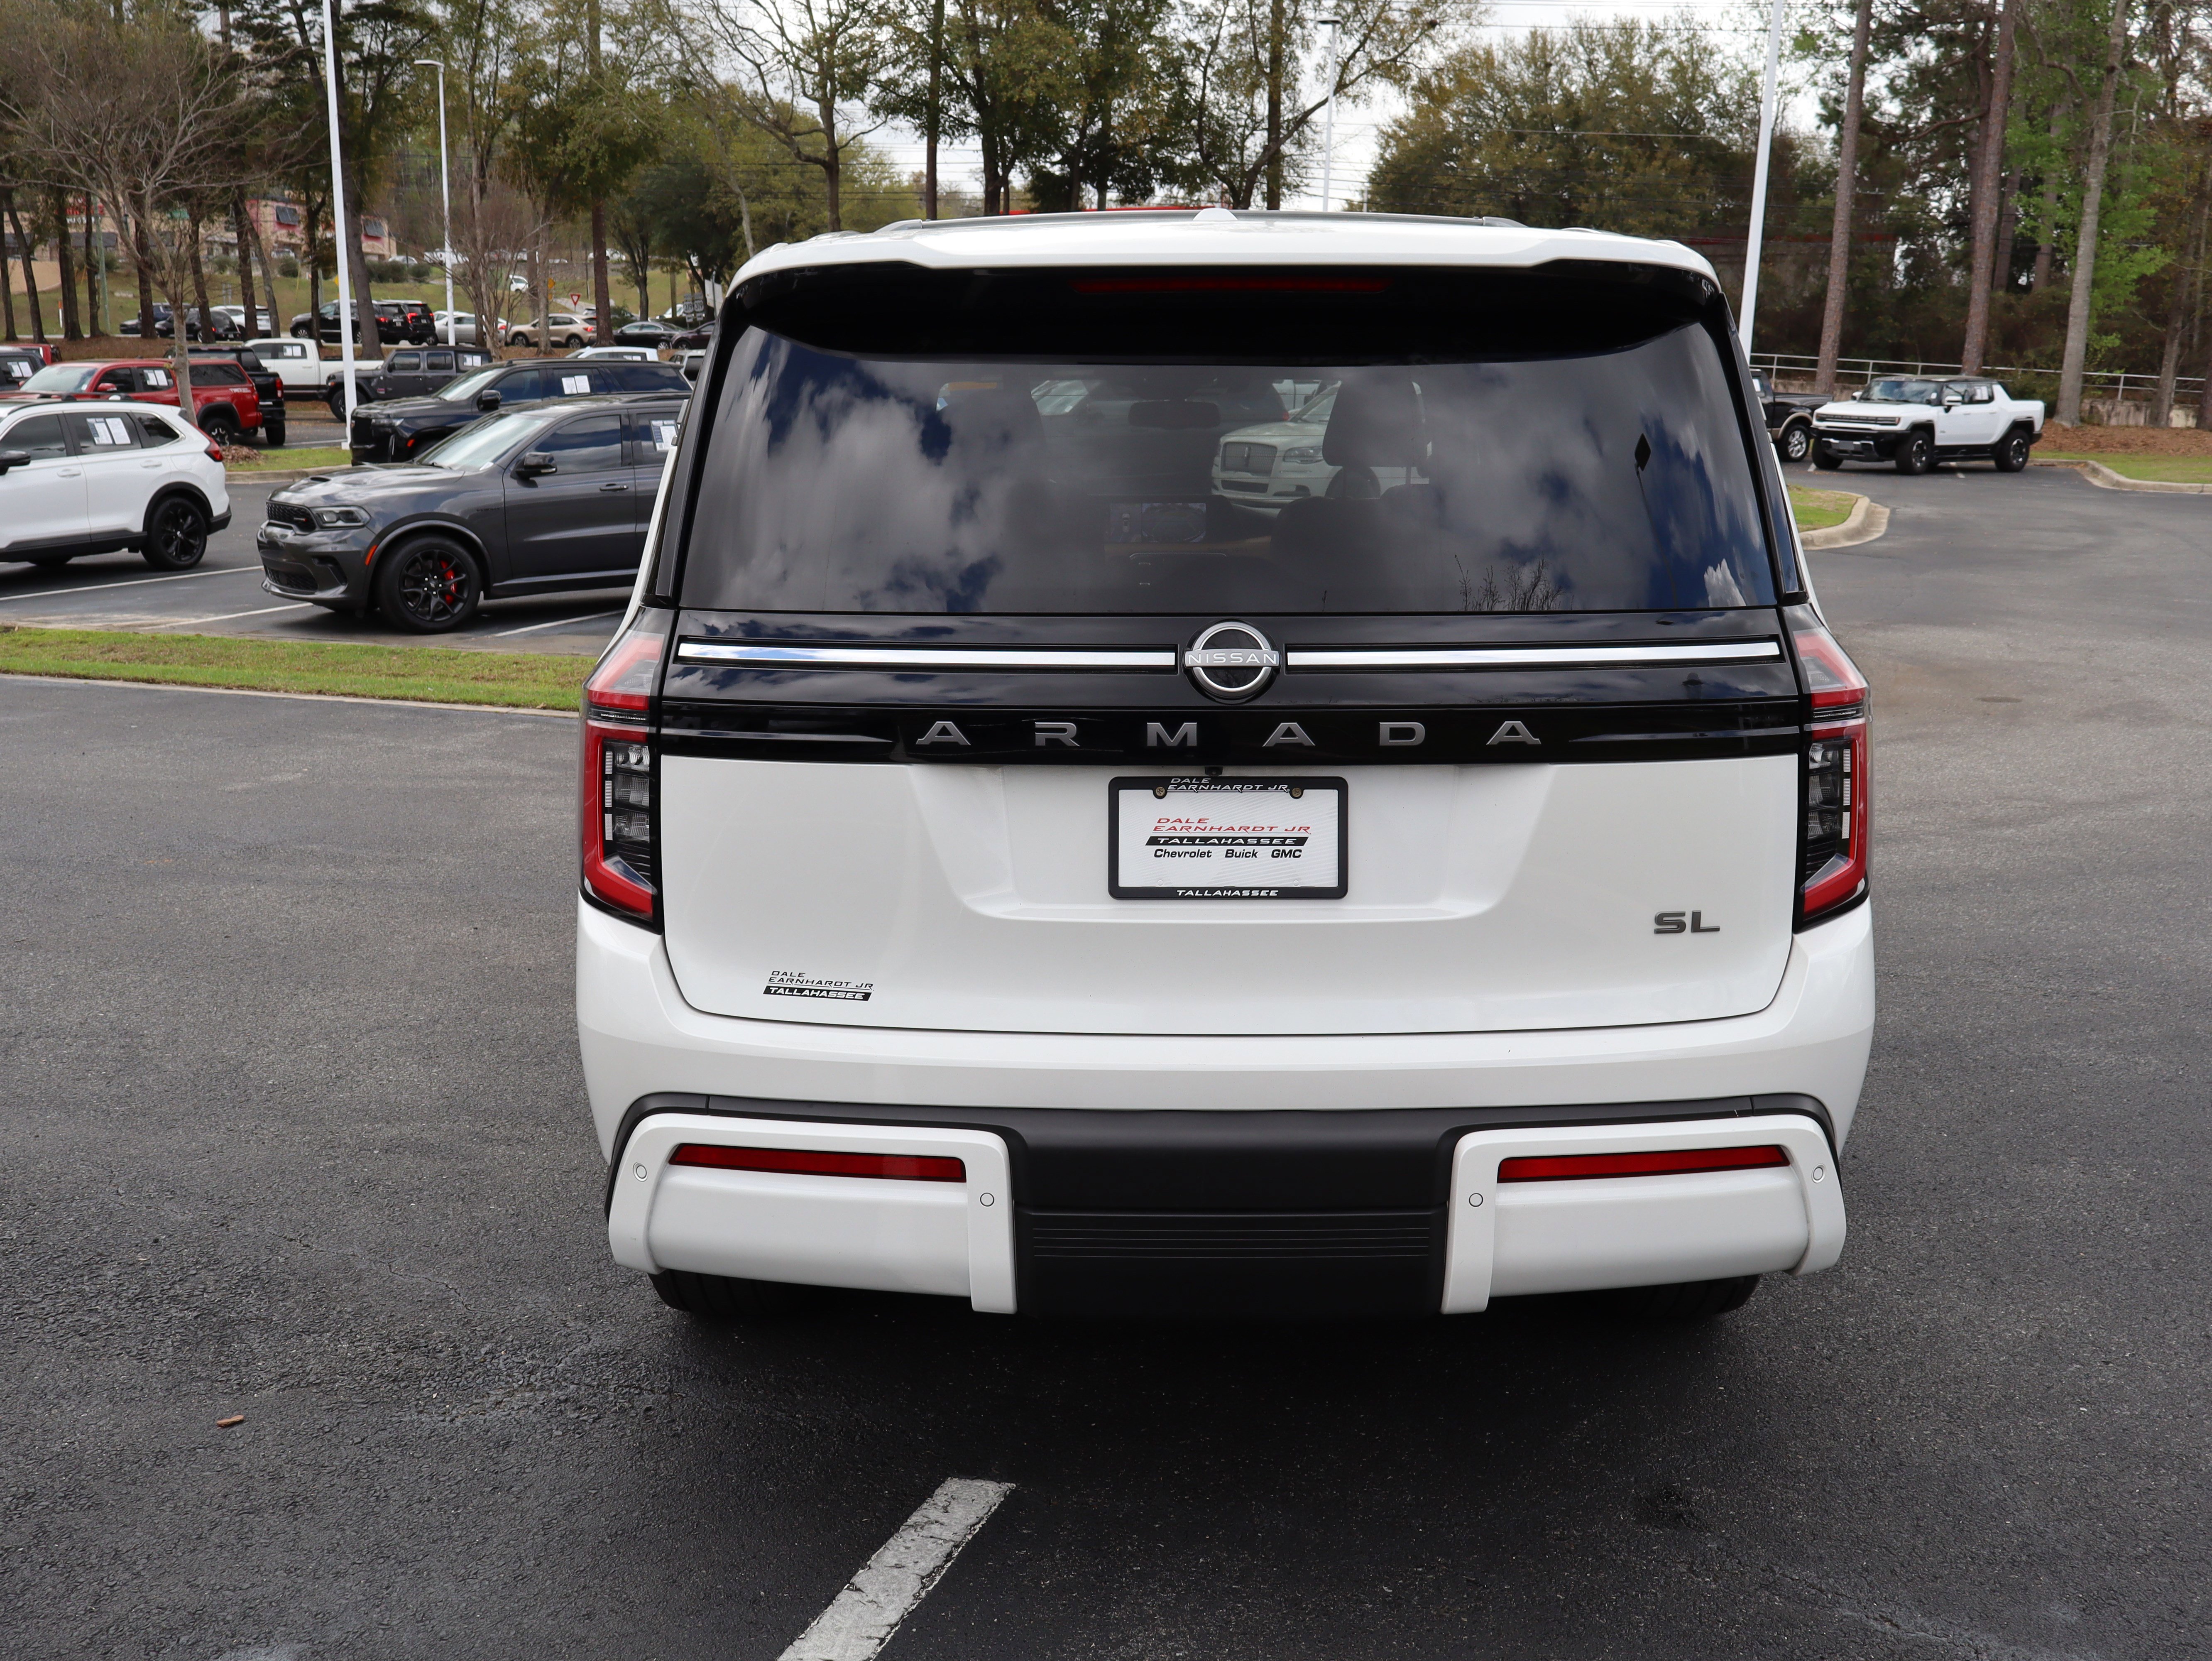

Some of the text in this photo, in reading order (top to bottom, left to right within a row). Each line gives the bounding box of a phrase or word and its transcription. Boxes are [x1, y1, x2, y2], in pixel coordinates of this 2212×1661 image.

[1188, 653, 1277, 664] NISSAN
[916, 721, 1542, 747] ARMADA
[1154, 849, 1302, 858] Chevrolet Buick GMC
[1654, 910, 1720, 934] SL
[768, 977, 852, 988] EARNHARDT
[769, 987, 865, 1000] TALLAHASSEE
